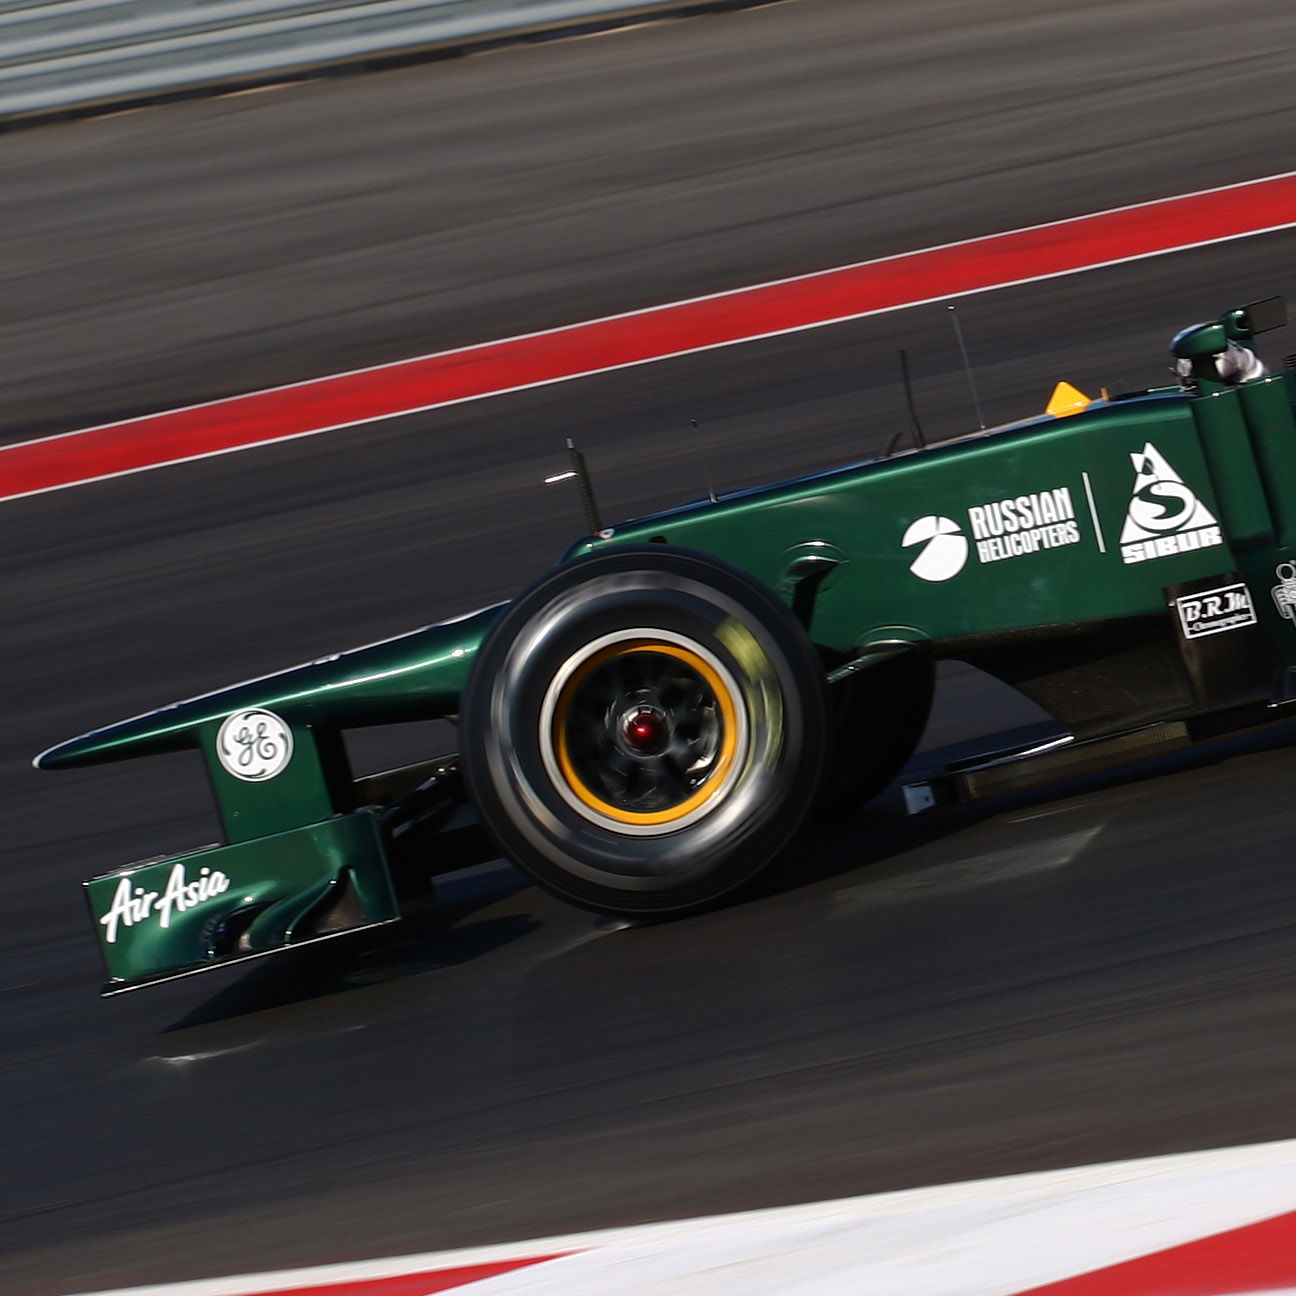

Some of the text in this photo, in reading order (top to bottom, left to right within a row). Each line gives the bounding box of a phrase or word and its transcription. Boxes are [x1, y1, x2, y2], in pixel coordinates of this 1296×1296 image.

[968, 487, 1074, 540] RUSSIAN
[976, 521, 1080, 563] HELICOPTERS
[1120, 525, 1223, 564] SIBUR
